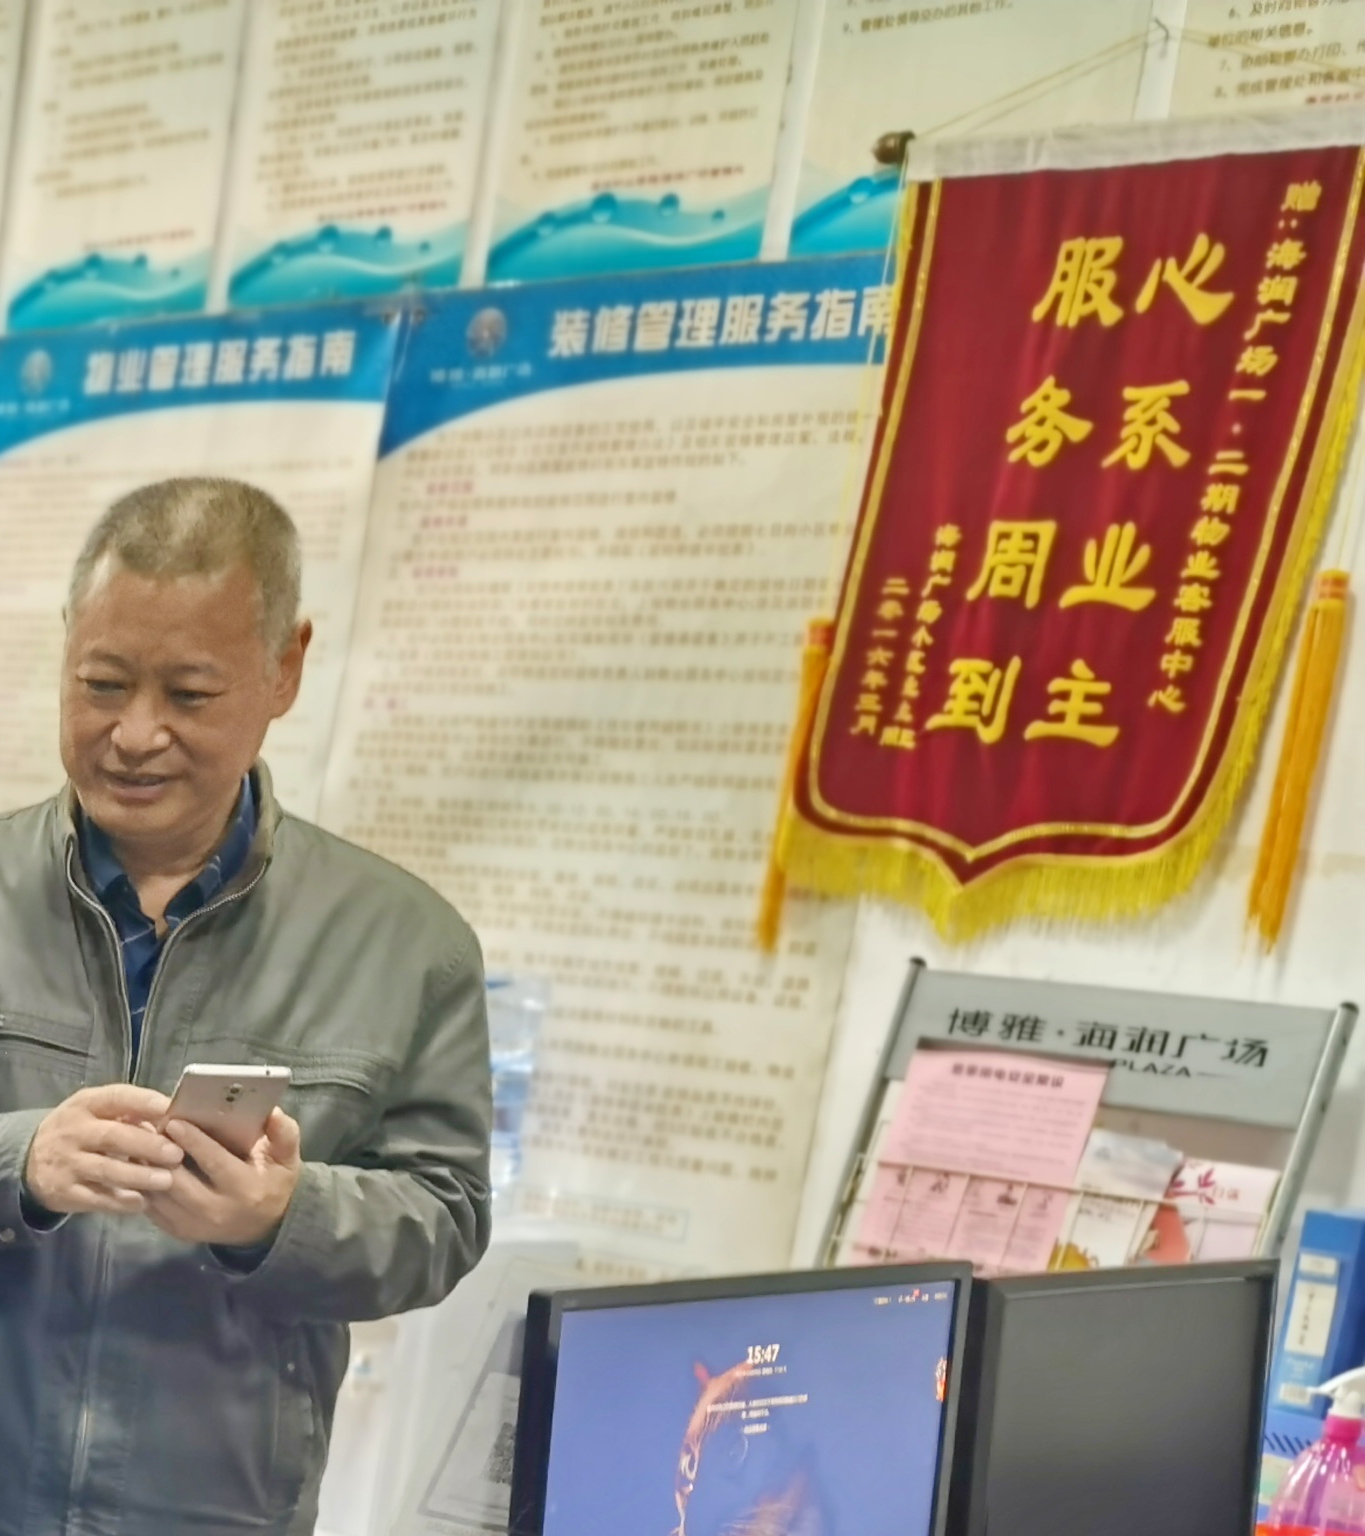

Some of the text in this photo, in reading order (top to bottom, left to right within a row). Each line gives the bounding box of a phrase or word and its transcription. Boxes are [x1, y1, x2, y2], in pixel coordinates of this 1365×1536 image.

[83, 331, 356, 396] 物业管理服务指南
[547, 283, 896, 360] 装修管理服务指南
[925, 235, 1124, 746] 服务周到
[1024, 233, 1234, 746] 心系业主
